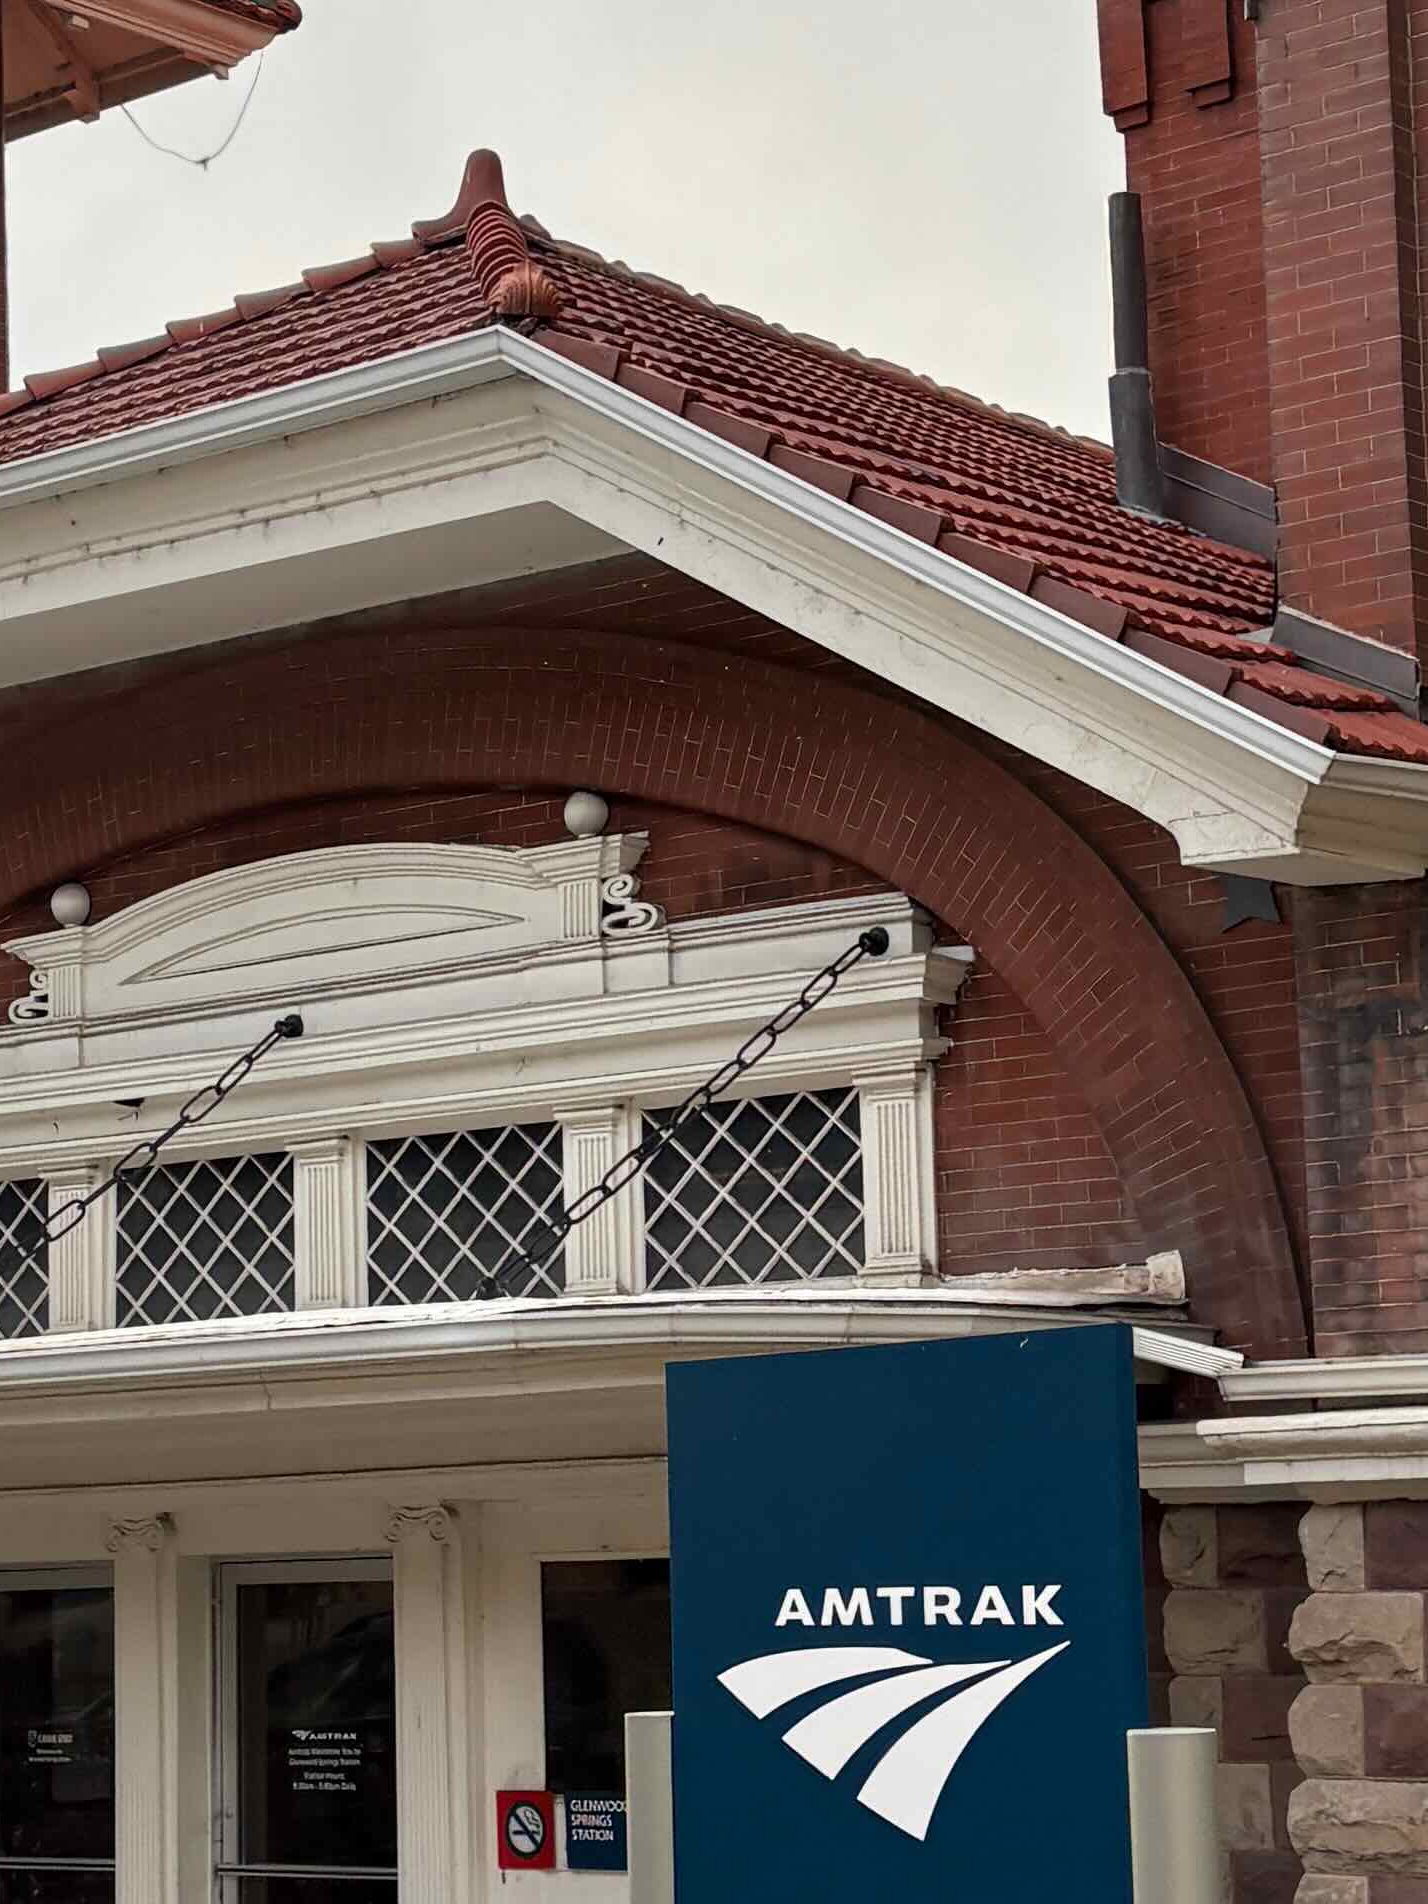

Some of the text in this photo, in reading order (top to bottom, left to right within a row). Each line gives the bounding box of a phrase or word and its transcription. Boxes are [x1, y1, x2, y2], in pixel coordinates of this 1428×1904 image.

[774, 1584, 1065, 1627] AMTRAK
[570, 1799, 626, 1812] GLENWOO
[571, 1813, 612, 1827] SPRINGS
[571, 1828, 614, 1841] STATION
